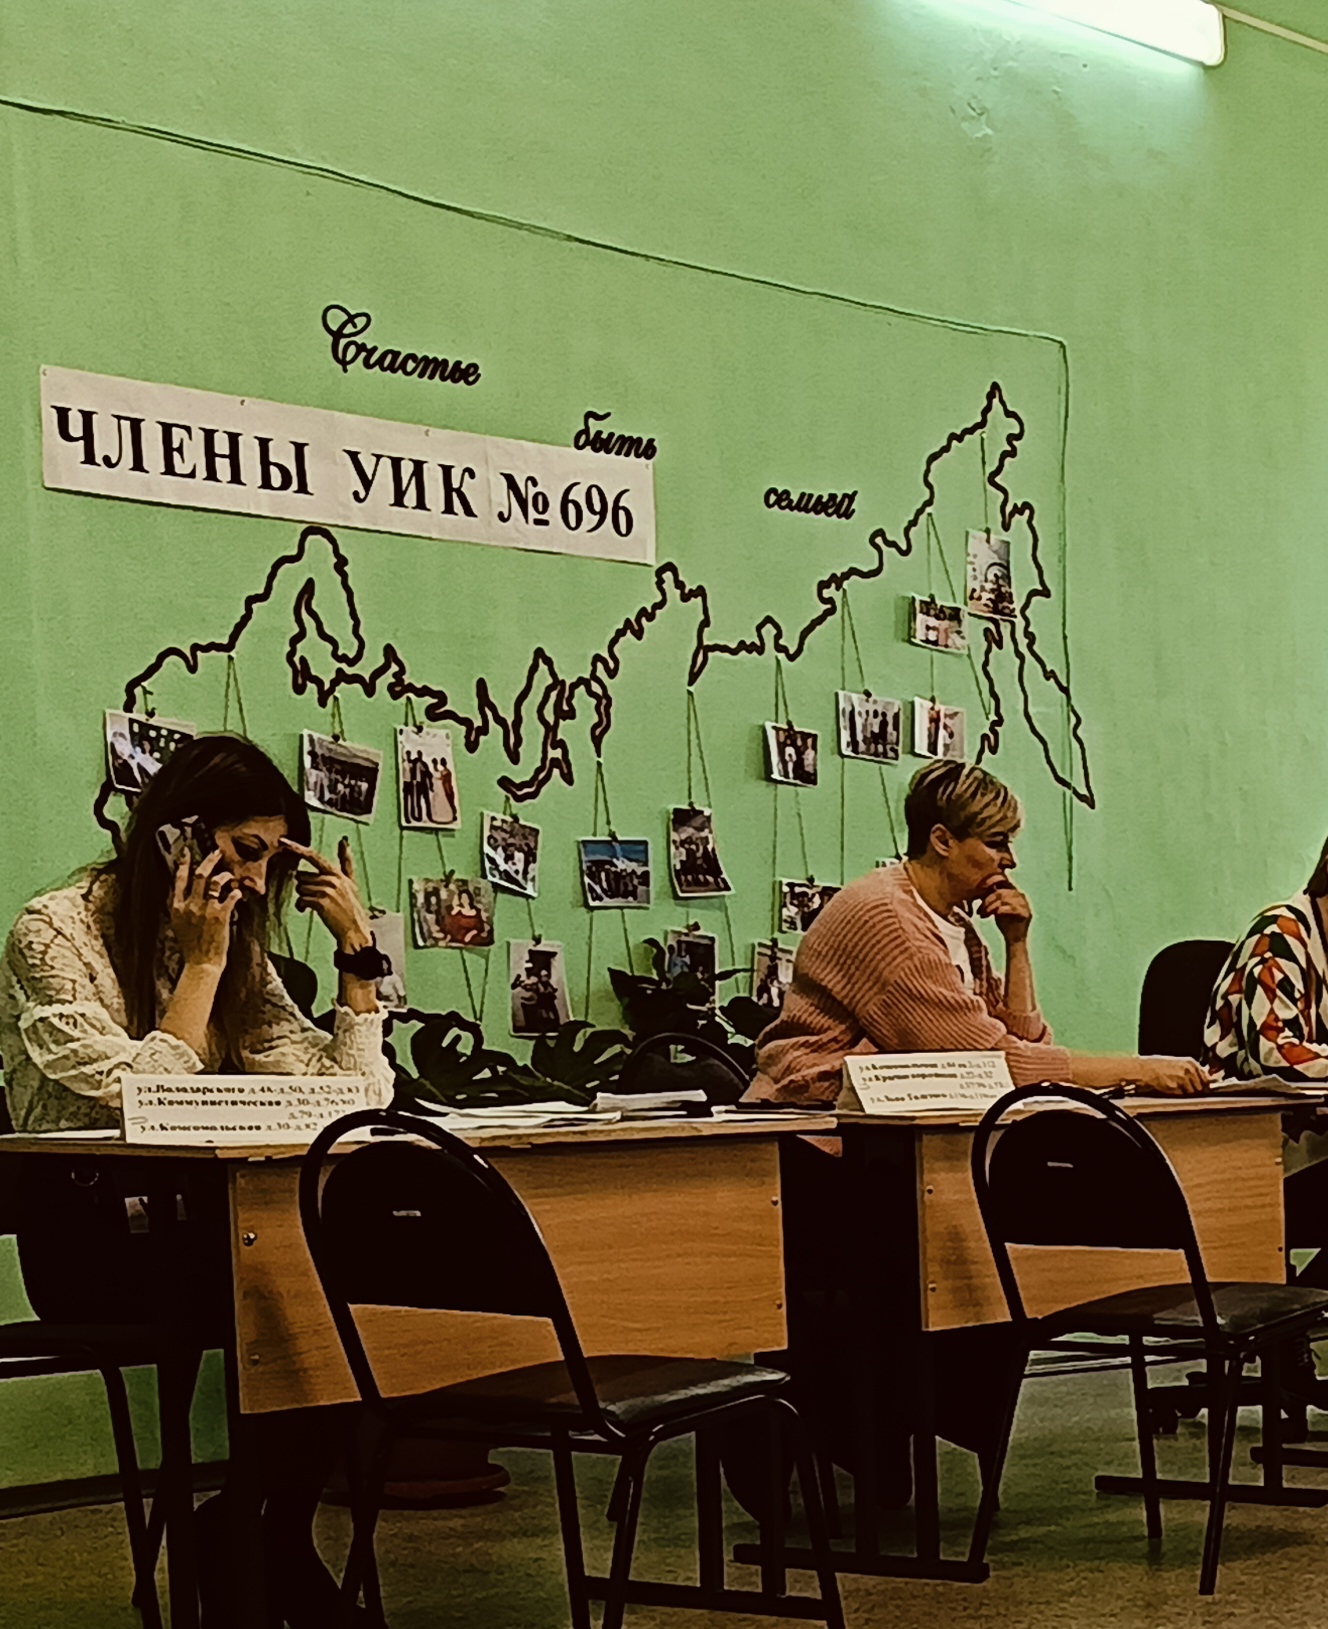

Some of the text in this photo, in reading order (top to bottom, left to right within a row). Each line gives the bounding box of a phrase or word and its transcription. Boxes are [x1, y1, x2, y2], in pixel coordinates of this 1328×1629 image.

[322, 304, 481, 386] Счастье
[50, 405, 314, 496] ЧЛЕНЫ
[342, 449, 478, 518] УИК
[573, 410, 657, 460] быть
